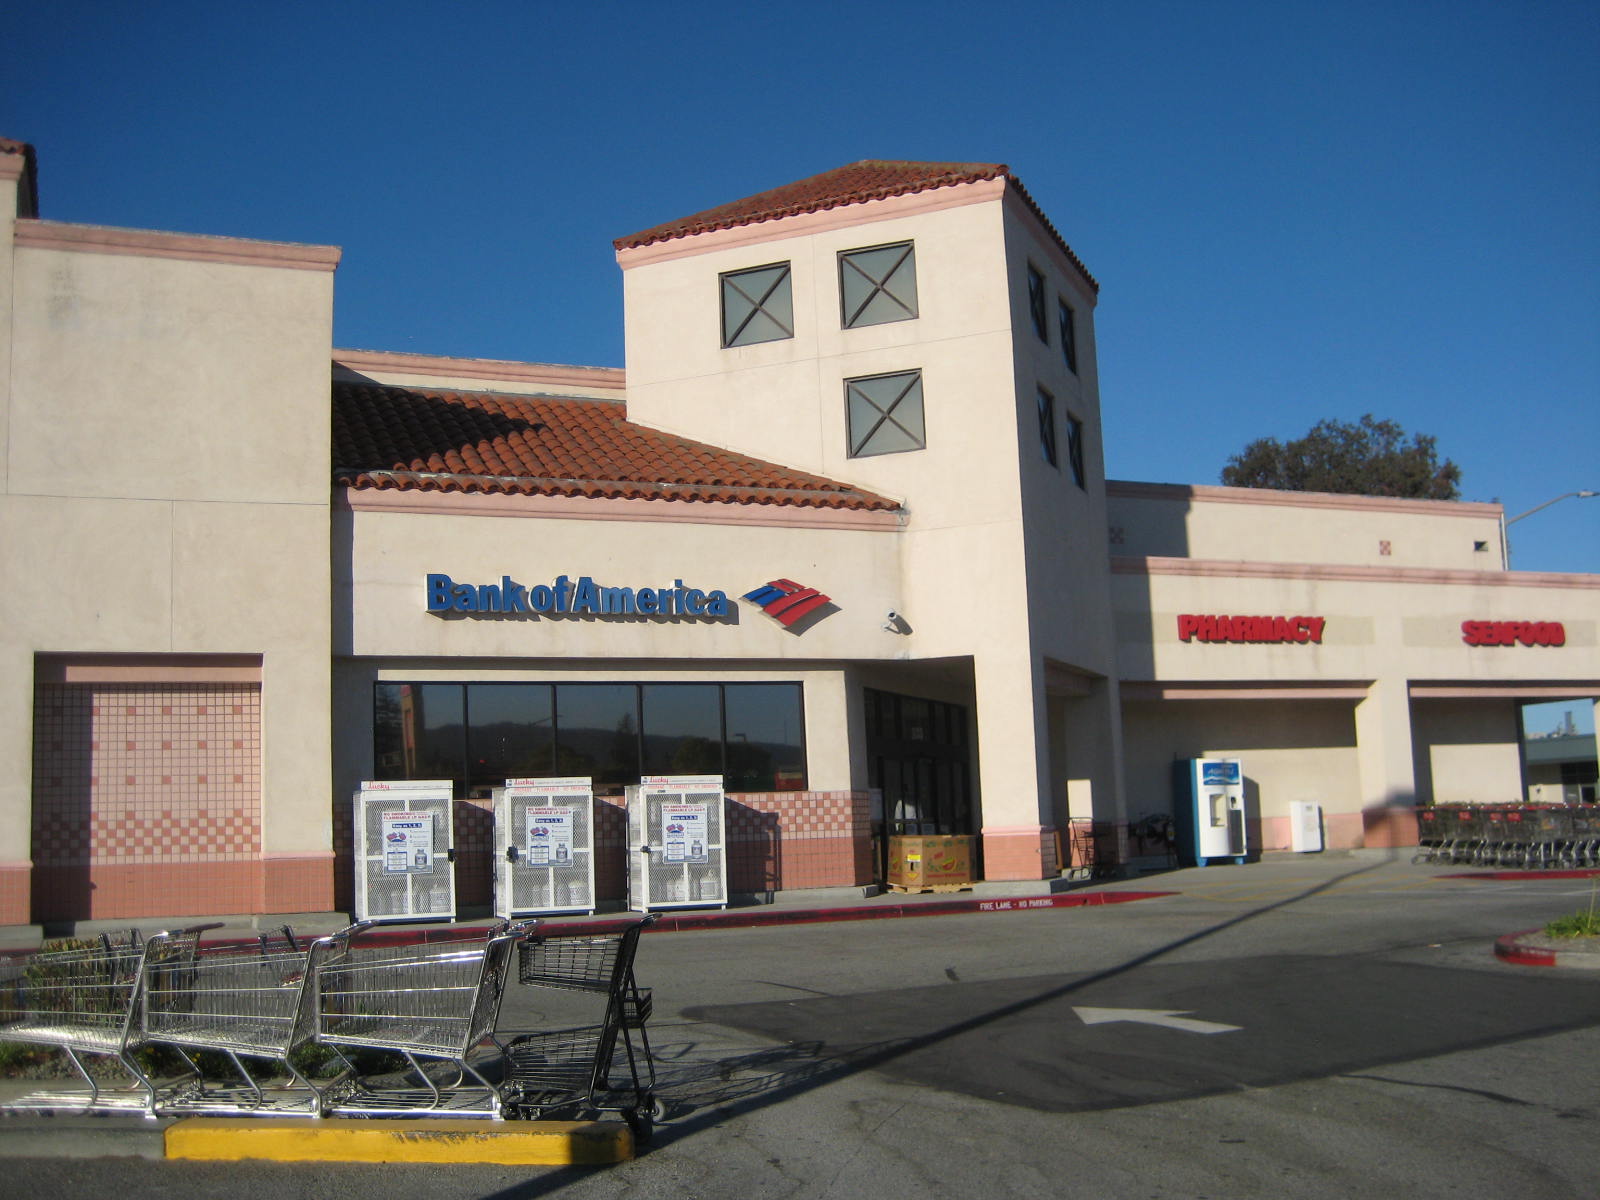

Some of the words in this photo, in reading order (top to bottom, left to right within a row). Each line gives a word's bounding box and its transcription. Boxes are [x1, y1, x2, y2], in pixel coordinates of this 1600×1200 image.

[425, 573, 527, 613] Bank
[528, 575, 570, 613] of
[571, 576, 728, 616] America
[1177, 614, 1325, 643] PHARMACY
[1461, 620, 1565, 646] SEAFOOD
[368, 780, 390, 790] Lucky
[514, 779, 535, 787] Lucky
[649, 776, 669, 784] Lucky
[980, 902, 995, 911] FIRE
[995, 901, 1012, 910] LANE
[1019, 900, 1028, 908] NO
[1029, 899, 1053, 907] PARKING
